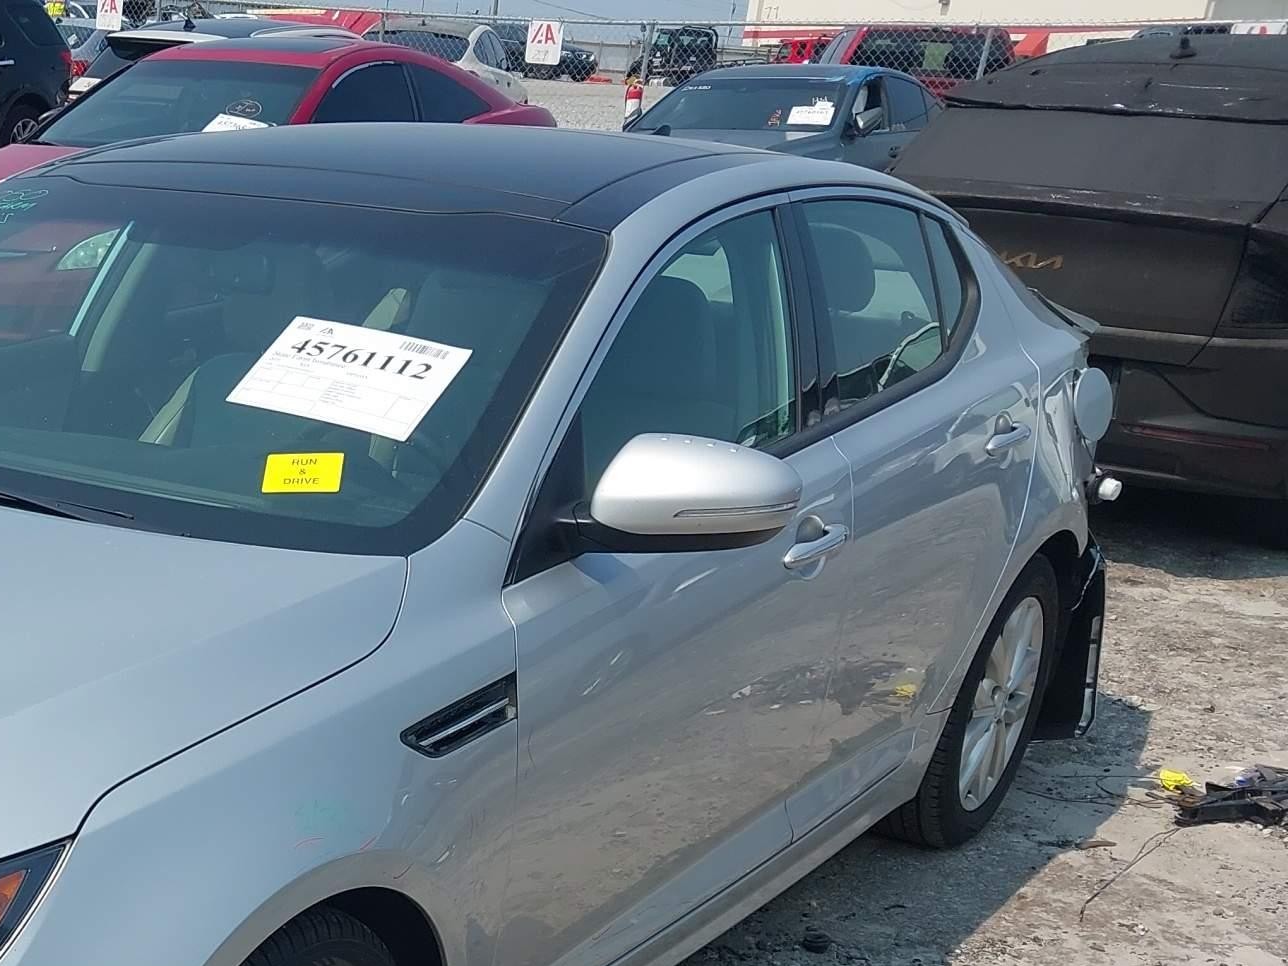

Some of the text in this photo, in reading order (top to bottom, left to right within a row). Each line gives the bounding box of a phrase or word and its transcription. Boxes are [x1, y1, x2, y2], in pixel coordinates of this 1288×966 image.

[291, 339, 433, 380] 45761112
[292, 458, 318, 466] RUN
[283, 477, 320, 485] DRIVE
